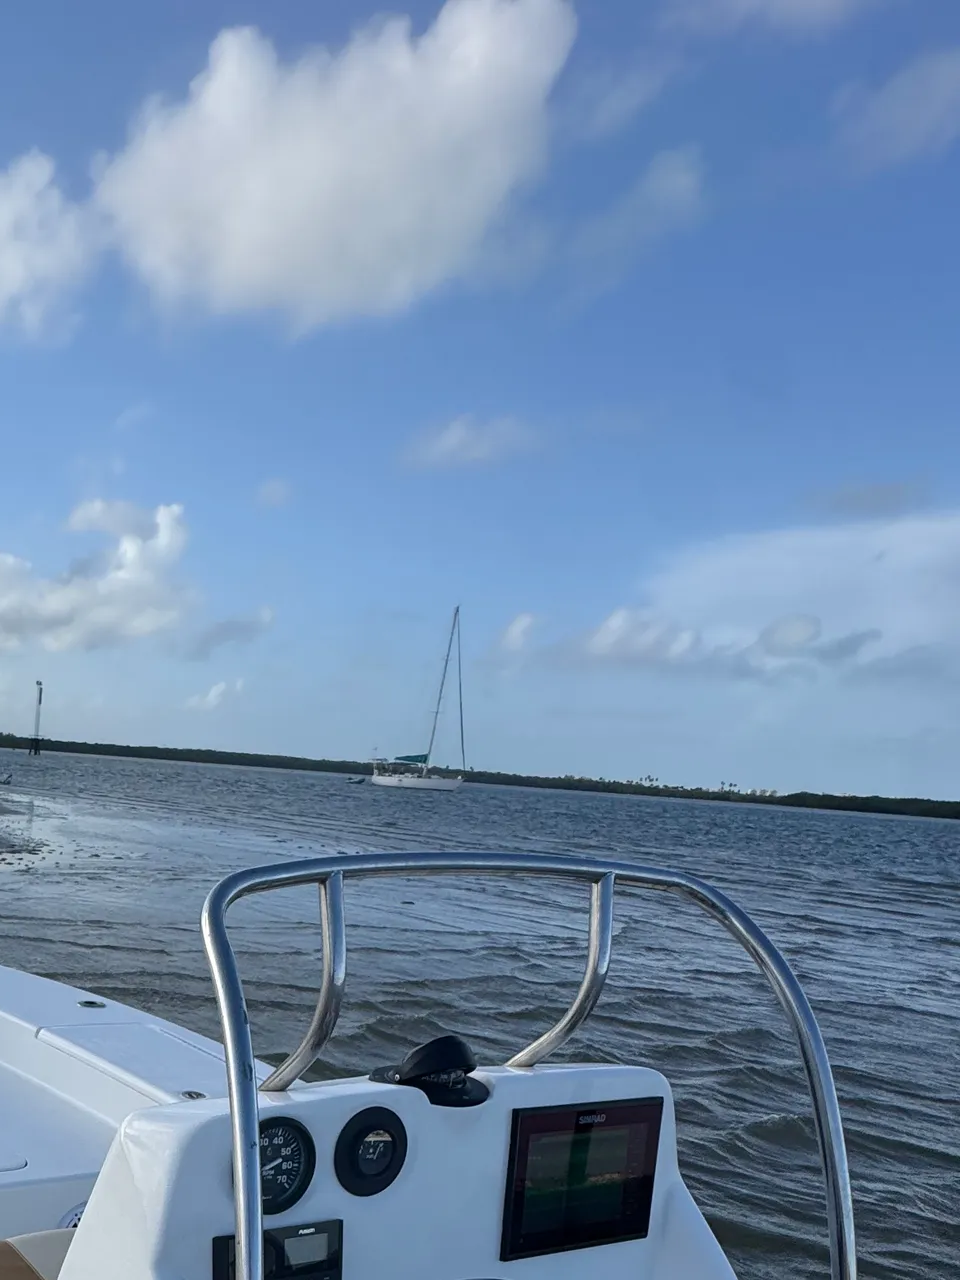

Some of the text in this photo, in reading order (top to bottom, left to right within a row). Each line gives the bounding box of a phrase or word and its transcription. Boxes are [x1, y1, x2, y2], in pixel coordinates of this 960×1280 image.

[272, 1136, 284, 1145] 40
[280, 1147, 292, 1156] 50
[282, 1161, 293, 1170] 60
[276, 1175, 287, 1184] 70
